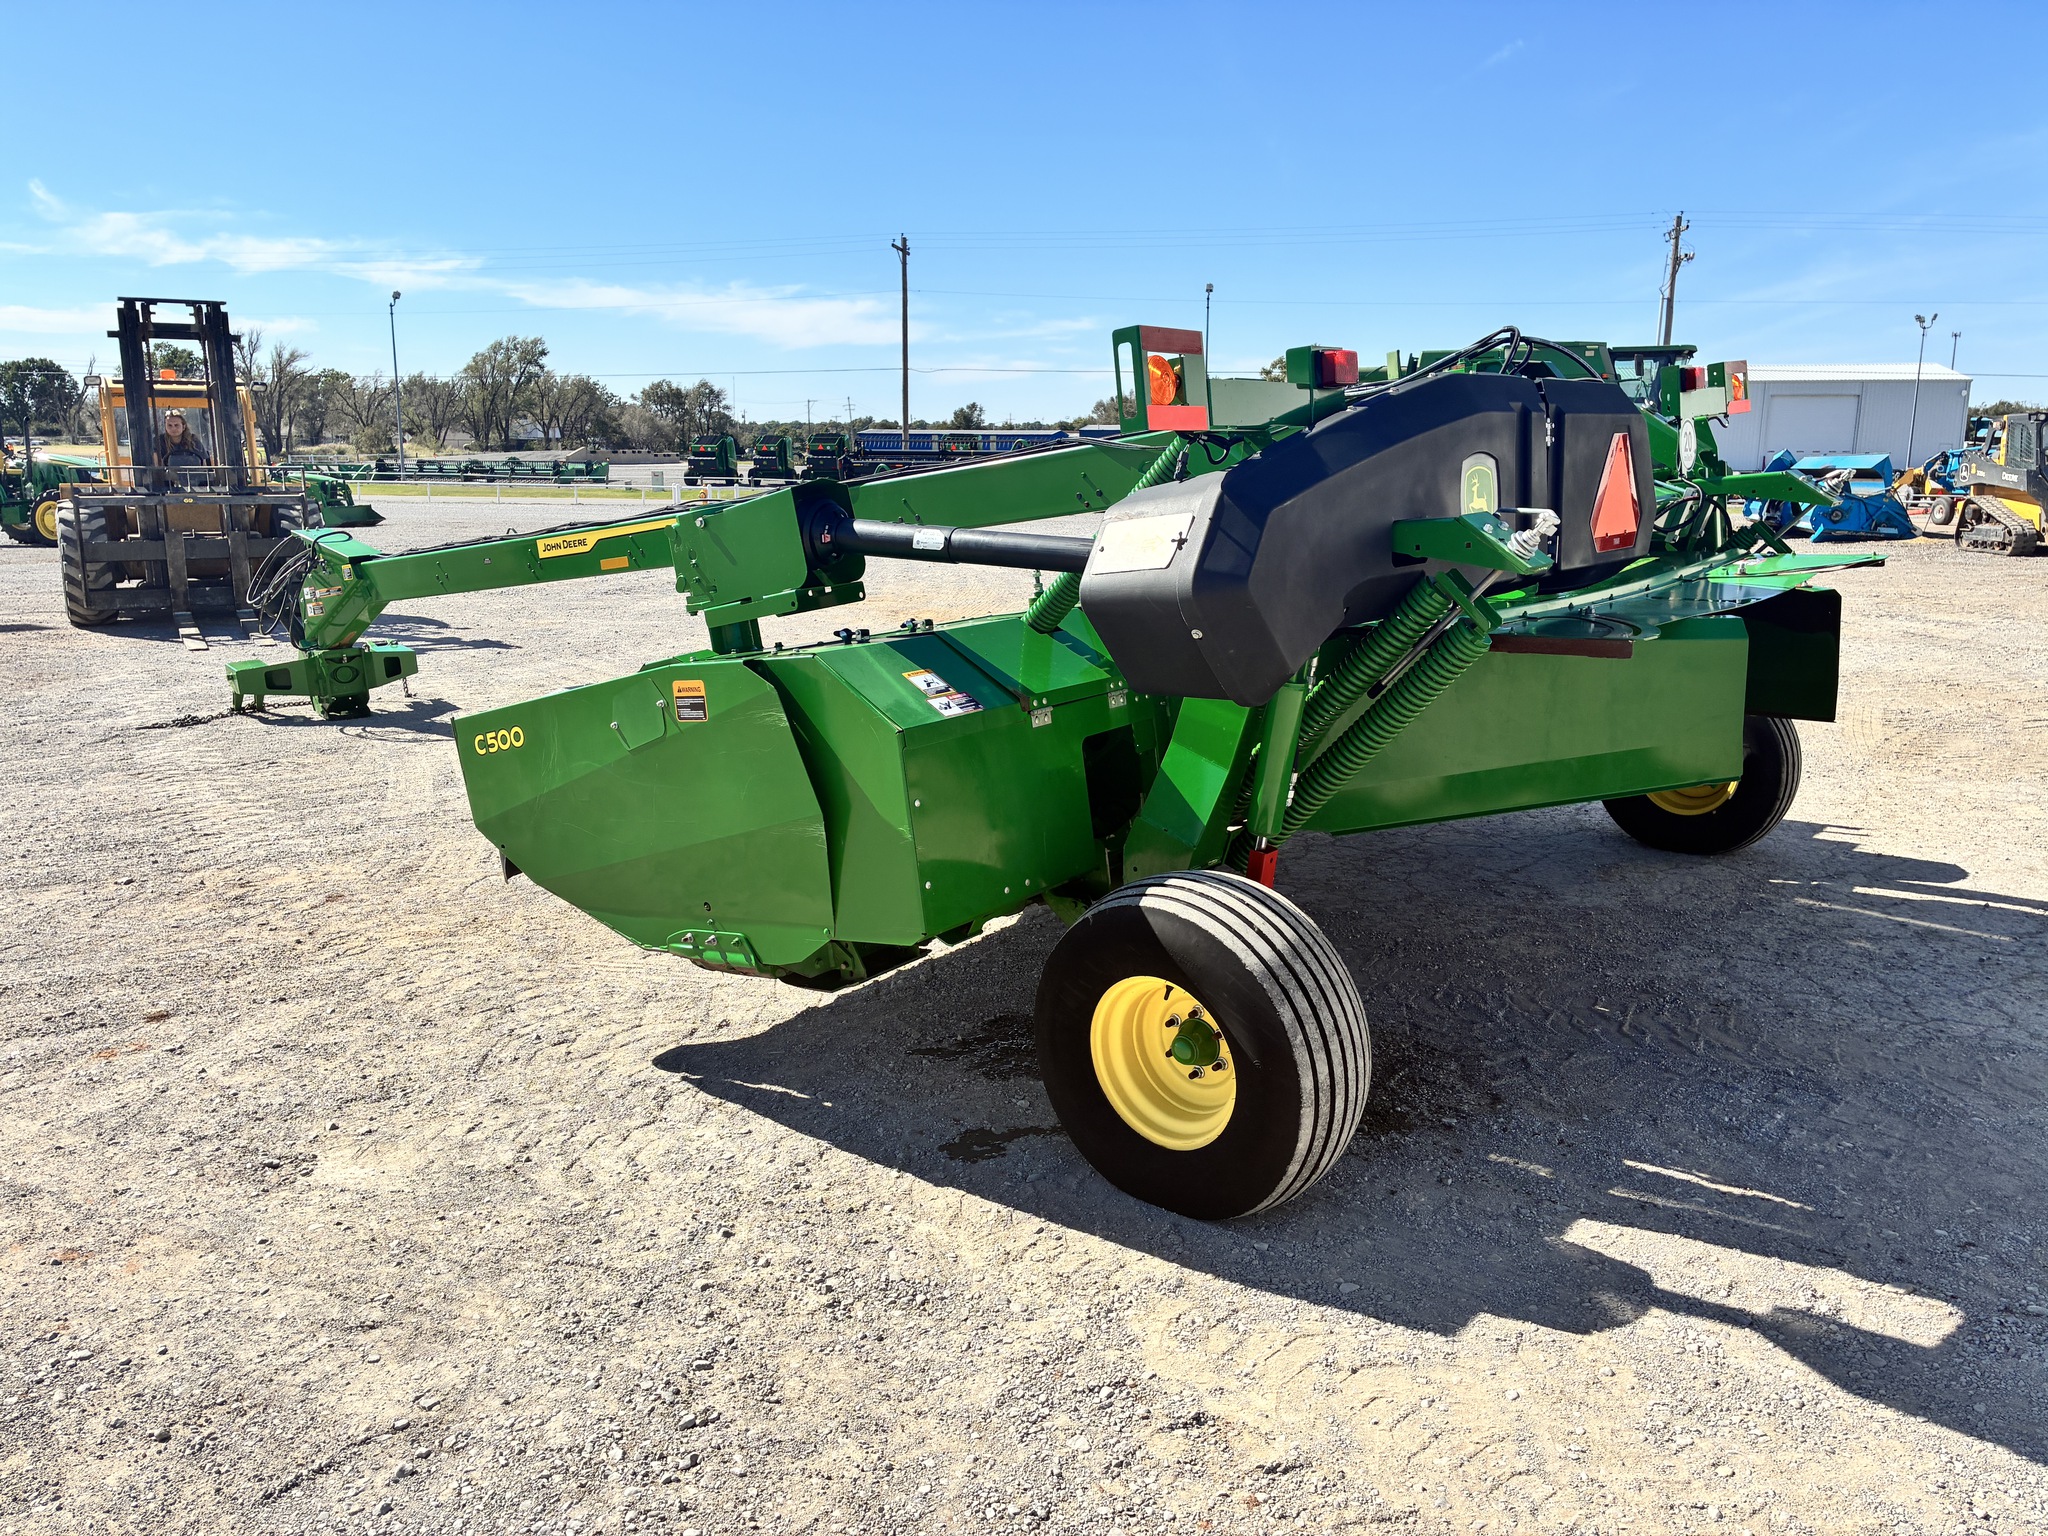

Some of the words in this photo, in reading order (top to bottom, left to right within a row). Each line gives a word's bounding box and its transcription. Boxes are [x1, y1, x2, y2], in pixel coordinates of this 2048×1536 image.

[1684, 431, 1693, 452] 20
[542, 542, 562, 552] JOHN
[562, 538, 588, 549] DEERE
[474, 725, 525, 756] C500
